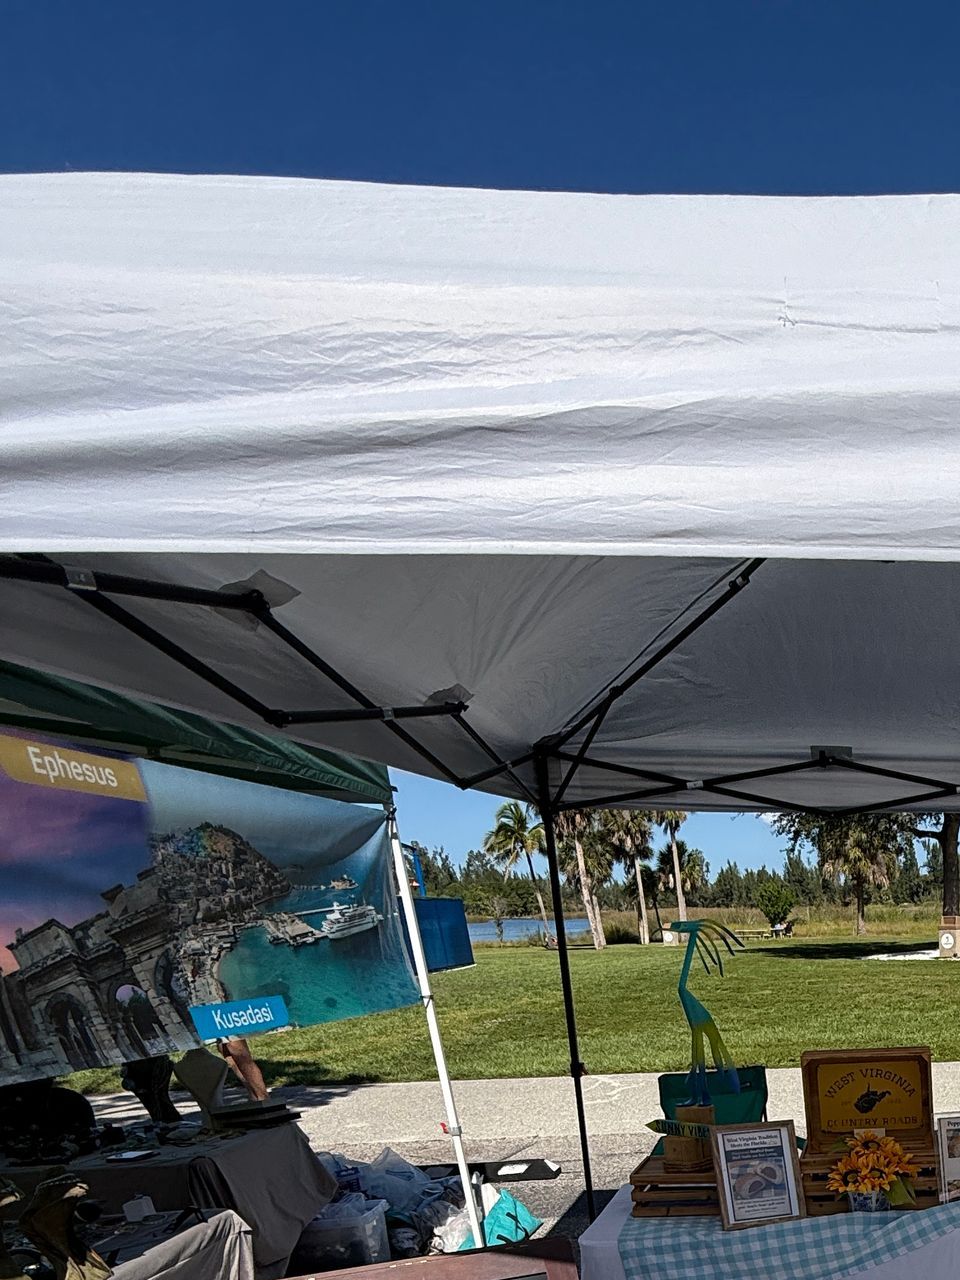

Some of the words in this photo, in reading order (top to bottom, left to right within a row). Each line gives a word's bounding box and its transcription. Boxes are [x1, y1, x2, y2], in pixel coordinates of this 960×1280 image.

[26, 746, 118, 788] Ephesus
[214, 1002, 274, 1031] Kusadasi
[825, 1071, 856, 1099] WEST
[860, 1068, 917, 1098] VIRGINIA
[827, 1118, 878, 1128] COUNTRY
[882, 1115, 918, 1126] ROADS
